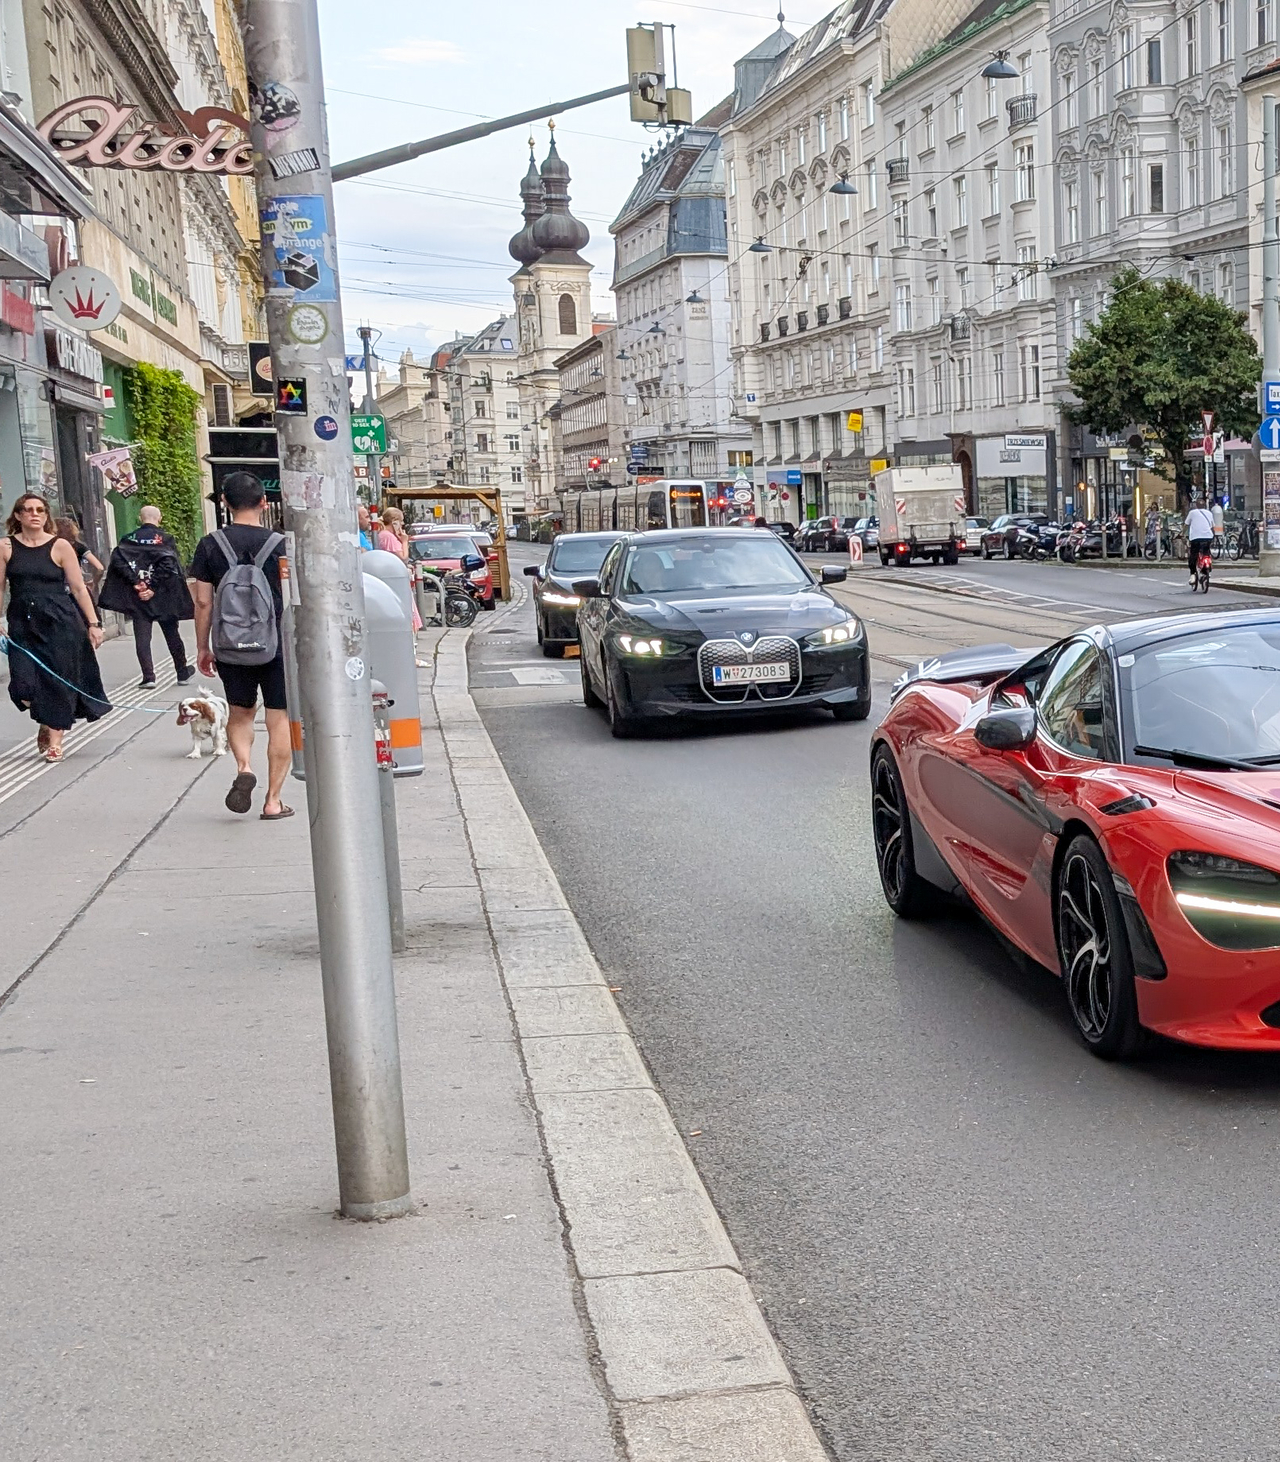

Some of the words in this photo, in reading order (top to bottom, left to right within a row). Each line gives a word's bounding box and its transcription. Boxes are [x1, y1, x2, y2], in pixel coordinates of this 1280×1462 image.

[723, 669, 731, 679] W
[741, 666, 776, 678] 27308
[779, 666, 785, 676] S
